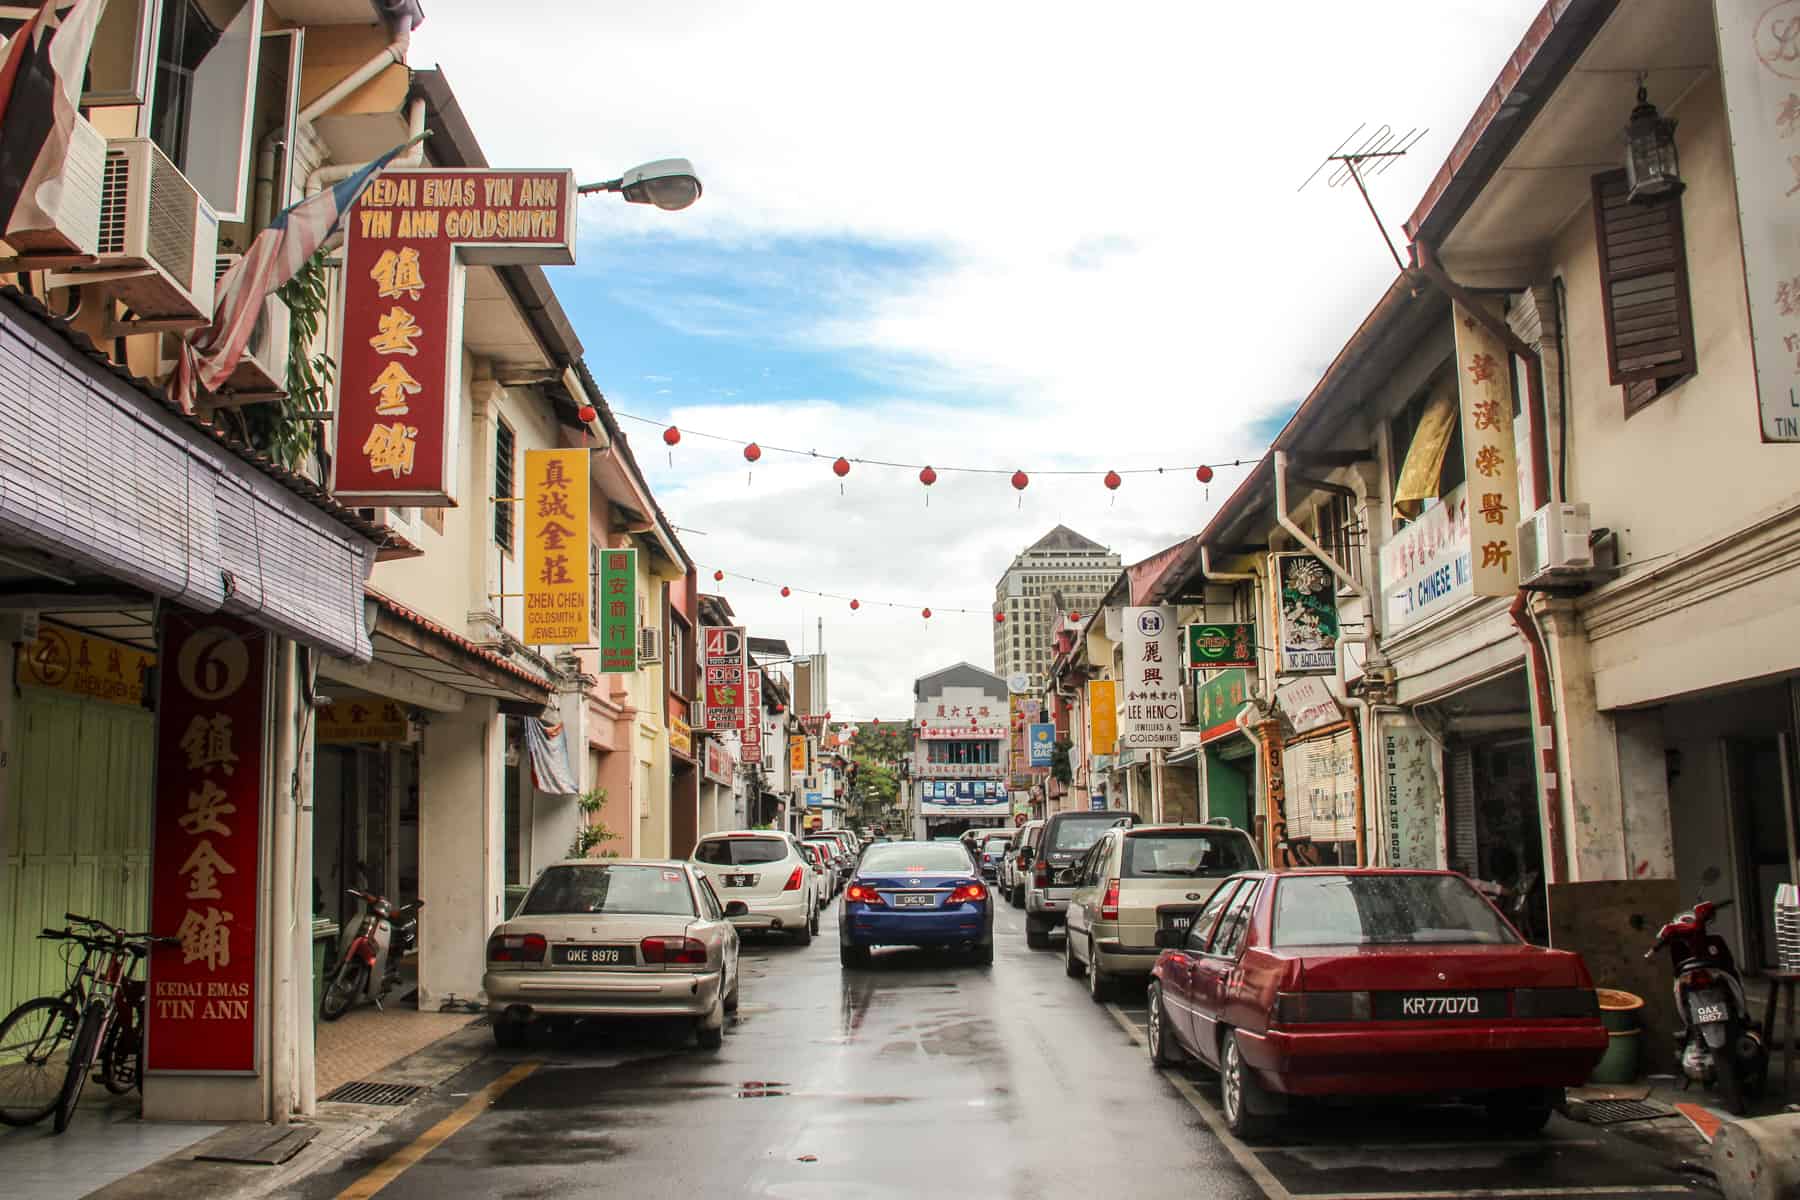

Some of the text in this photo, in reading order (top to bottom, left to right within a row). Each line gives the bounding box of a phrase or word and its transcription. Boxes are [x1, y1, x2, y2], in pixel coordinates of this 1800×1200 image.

[422, 178, 475, 207] EMAS
[519, 179, 559, 207] ANN
[397, 210, 440, 239] ANN
[445, 209, 558, 239] GOLDSMITH
[1418, 564, 1451, 607] CHINESE
[527, 592, 585, 609] ZHEN CHEN
[528, 611, 574, 624] GOLDSMITH
[531, 626, 577, 639] JEWELLERY
[707, 631, 740, 656] 4D
[1128, 704, 1142, 720] LEE
[156, 982, 249, 997] KEDAI EMAS
[158, 1001, 248, 1020] TIN ANN
